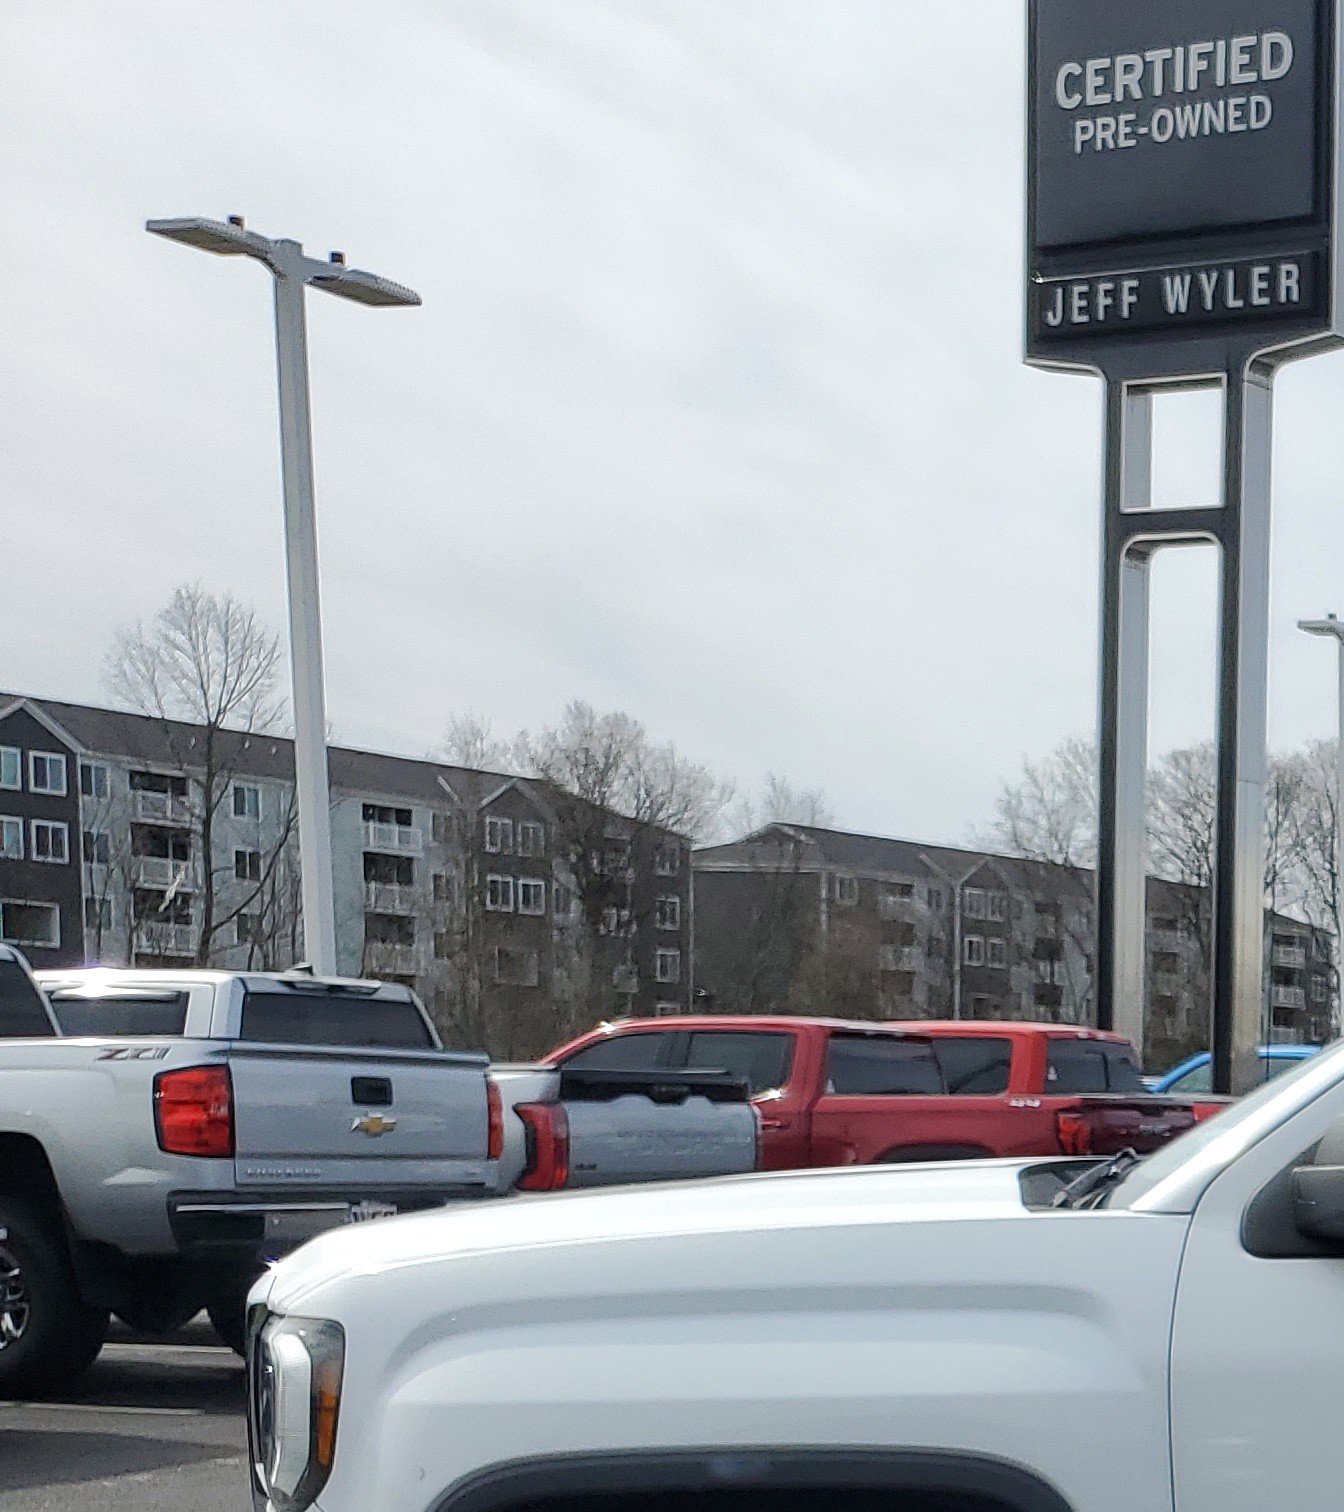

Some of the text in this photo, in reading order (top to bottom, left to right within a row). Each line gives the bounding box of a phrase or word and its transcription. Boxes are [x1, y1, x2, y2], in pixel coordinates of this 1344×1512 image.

[1055, 31, 1294, 110] CERTIFIED
[1073, 95, 1273, 154] PRE-OWNED
[1045, 262, 1300, 327] JEFF WYLER
